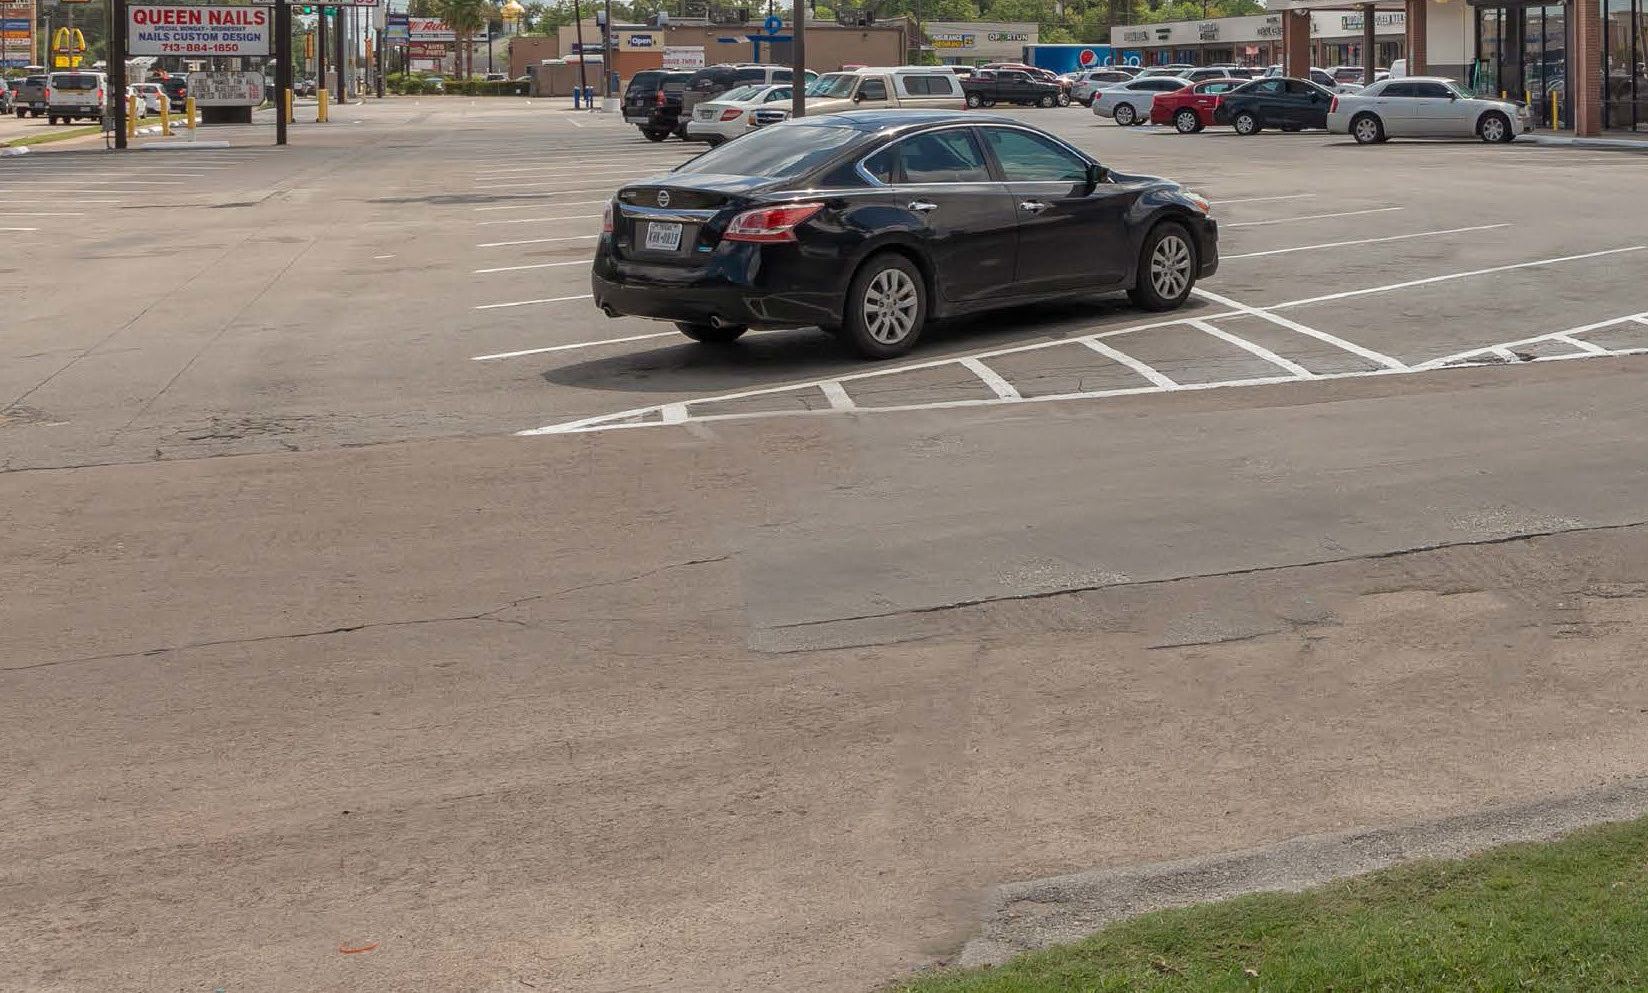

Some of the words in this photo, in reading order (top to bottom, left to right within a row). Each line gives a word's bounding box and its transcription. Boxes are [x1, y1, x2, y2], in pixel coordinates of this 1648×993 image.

[133, 9, 202, 25] QUEEN
[208, 10, 266, 26] NAILS
[138, 32, 170, 41] NAILS
[173, 32, 219, 42] CUSTOM
[222, 33, 261, 42] DESIGN
[632, 37, 652, 45] Open
[161, 43, 239, 52] 713-884-1850
